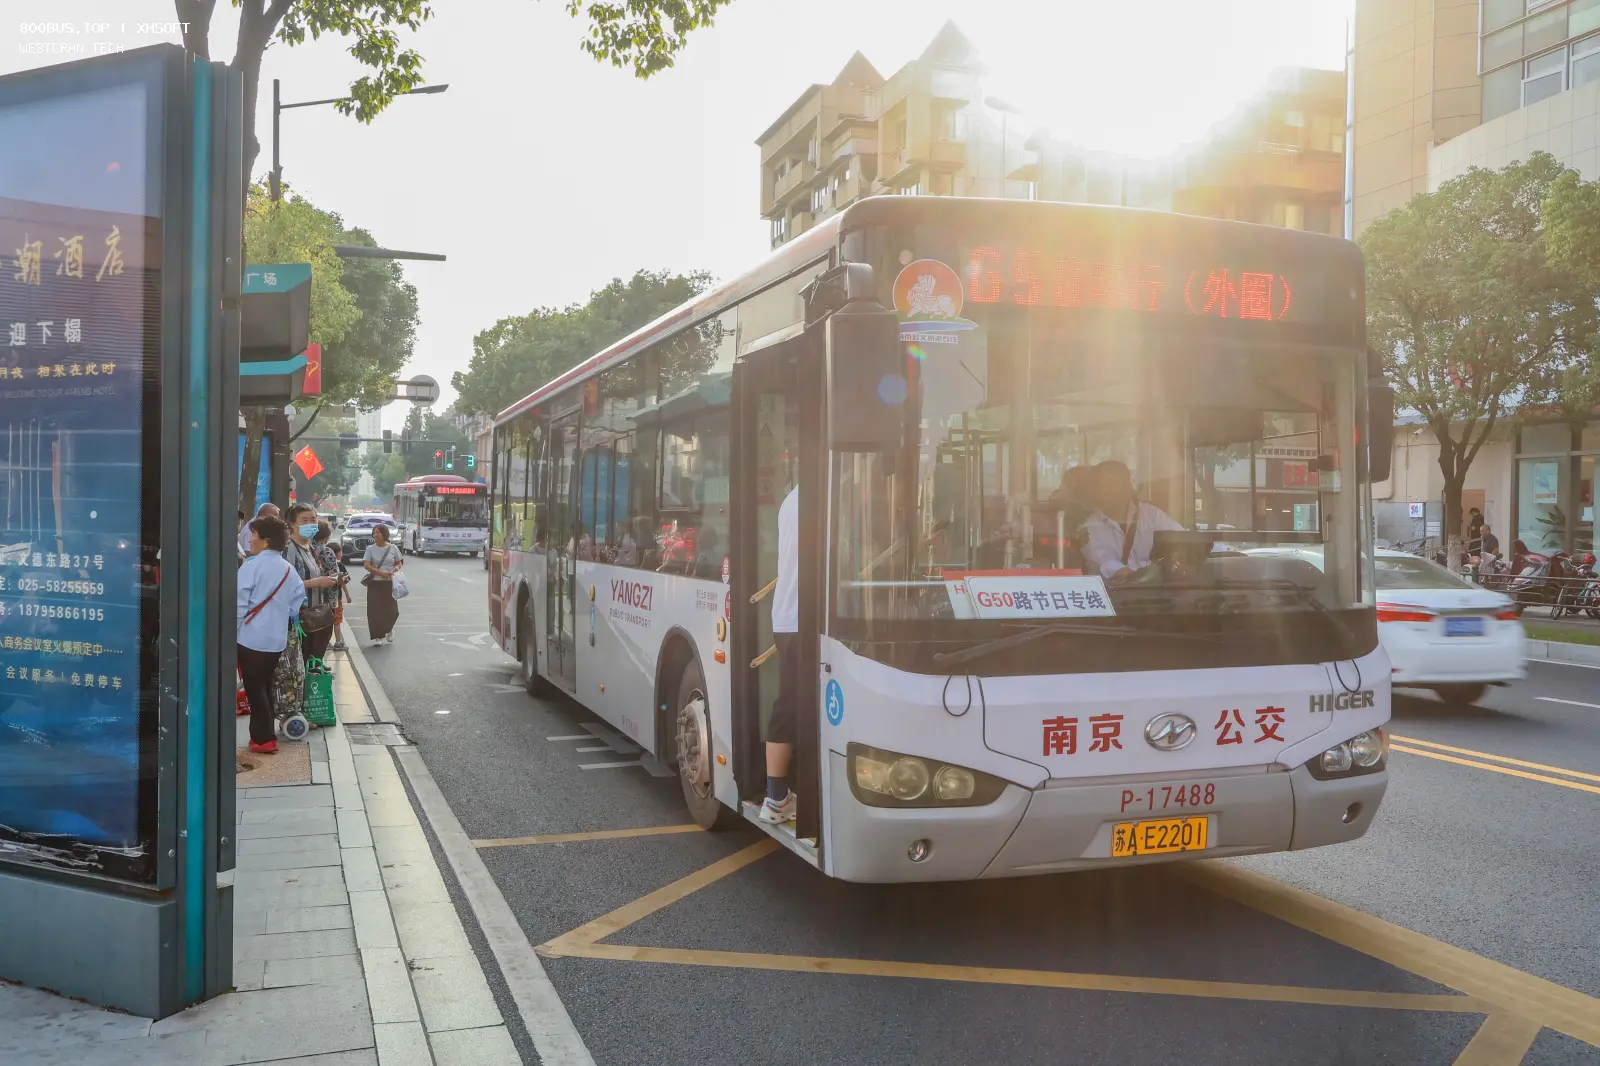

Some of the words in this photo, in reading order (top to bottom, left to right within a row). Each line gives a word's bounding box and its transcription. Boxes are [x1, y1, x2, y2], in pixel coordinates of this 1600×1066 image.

[0, 225, 125, 286] 潮酒店
[246, 272, 278, 288] 广场
[9, 318, 83, 347] 迎下榻
[37, 361, 118, 379] 相聚在此时
[93, 384, 117, 396] HOTEL
[610, 578, 655, 612] YANGZI
[976, 590, 1107, 611] G50路节日专线
[624, 612, 653, 629] TRANSPORT
[1309, 690, 1376, 714] HIGER
[1042, 712, 1124, 757] 南京
[1213, 705, 1287, 747] 公交
[1120, 782, 1217, 813] P-17488
